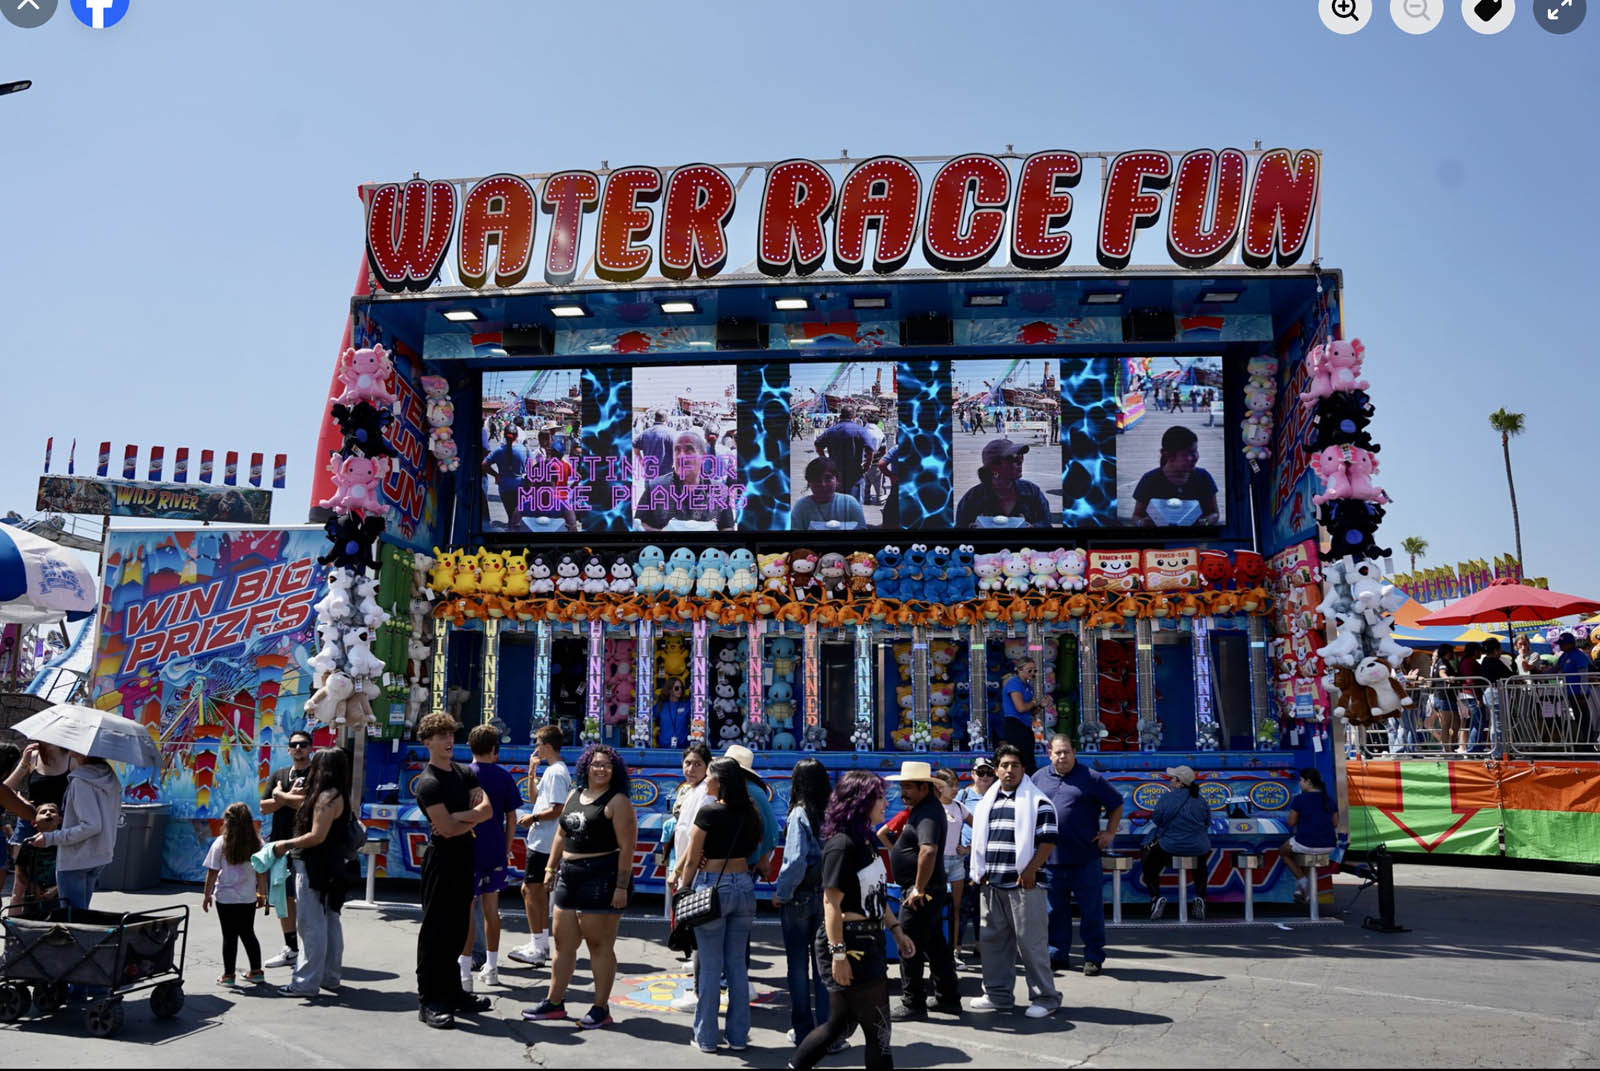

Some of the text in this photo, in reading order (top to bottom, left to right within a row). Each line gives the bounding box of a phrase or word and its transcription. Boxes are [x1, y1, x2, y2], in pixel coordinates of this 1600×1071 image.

[367, 147, 1320, 293] WATER RACE FUN
[116, 487, 200, 510] WILD RIVER
[517, 484, 749, 512] MORE PLAYERS
[526, 454, 738, 483] WAITING FOR
[123, 588, 318, 675] PRIZES
[126, 557, 314, 639] WIN BIG
[432, 618, 447, 714] WINNE
